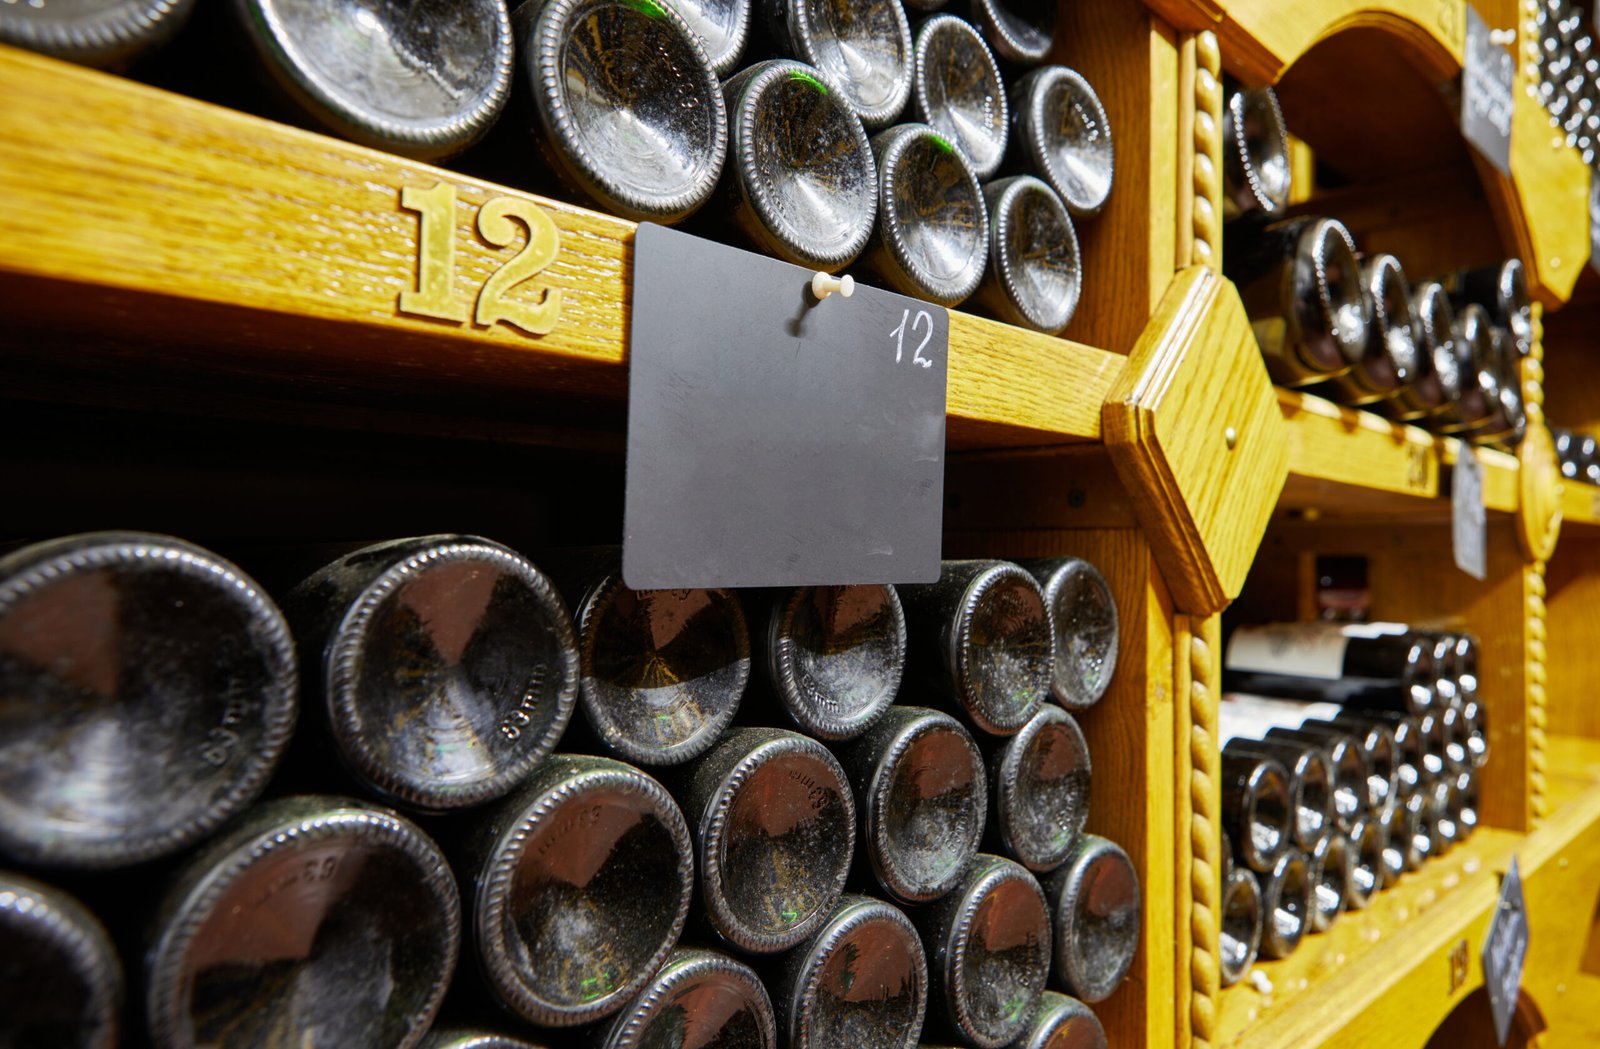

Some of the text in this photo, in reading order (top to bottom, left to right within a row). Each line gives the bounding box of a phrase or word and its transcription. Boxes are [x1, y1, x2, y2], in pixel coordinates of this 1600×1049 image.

[398, 182, 562, 336] 12
[889, 308, 934, 368] 12
[501, 663, 548, 740] 63mm
